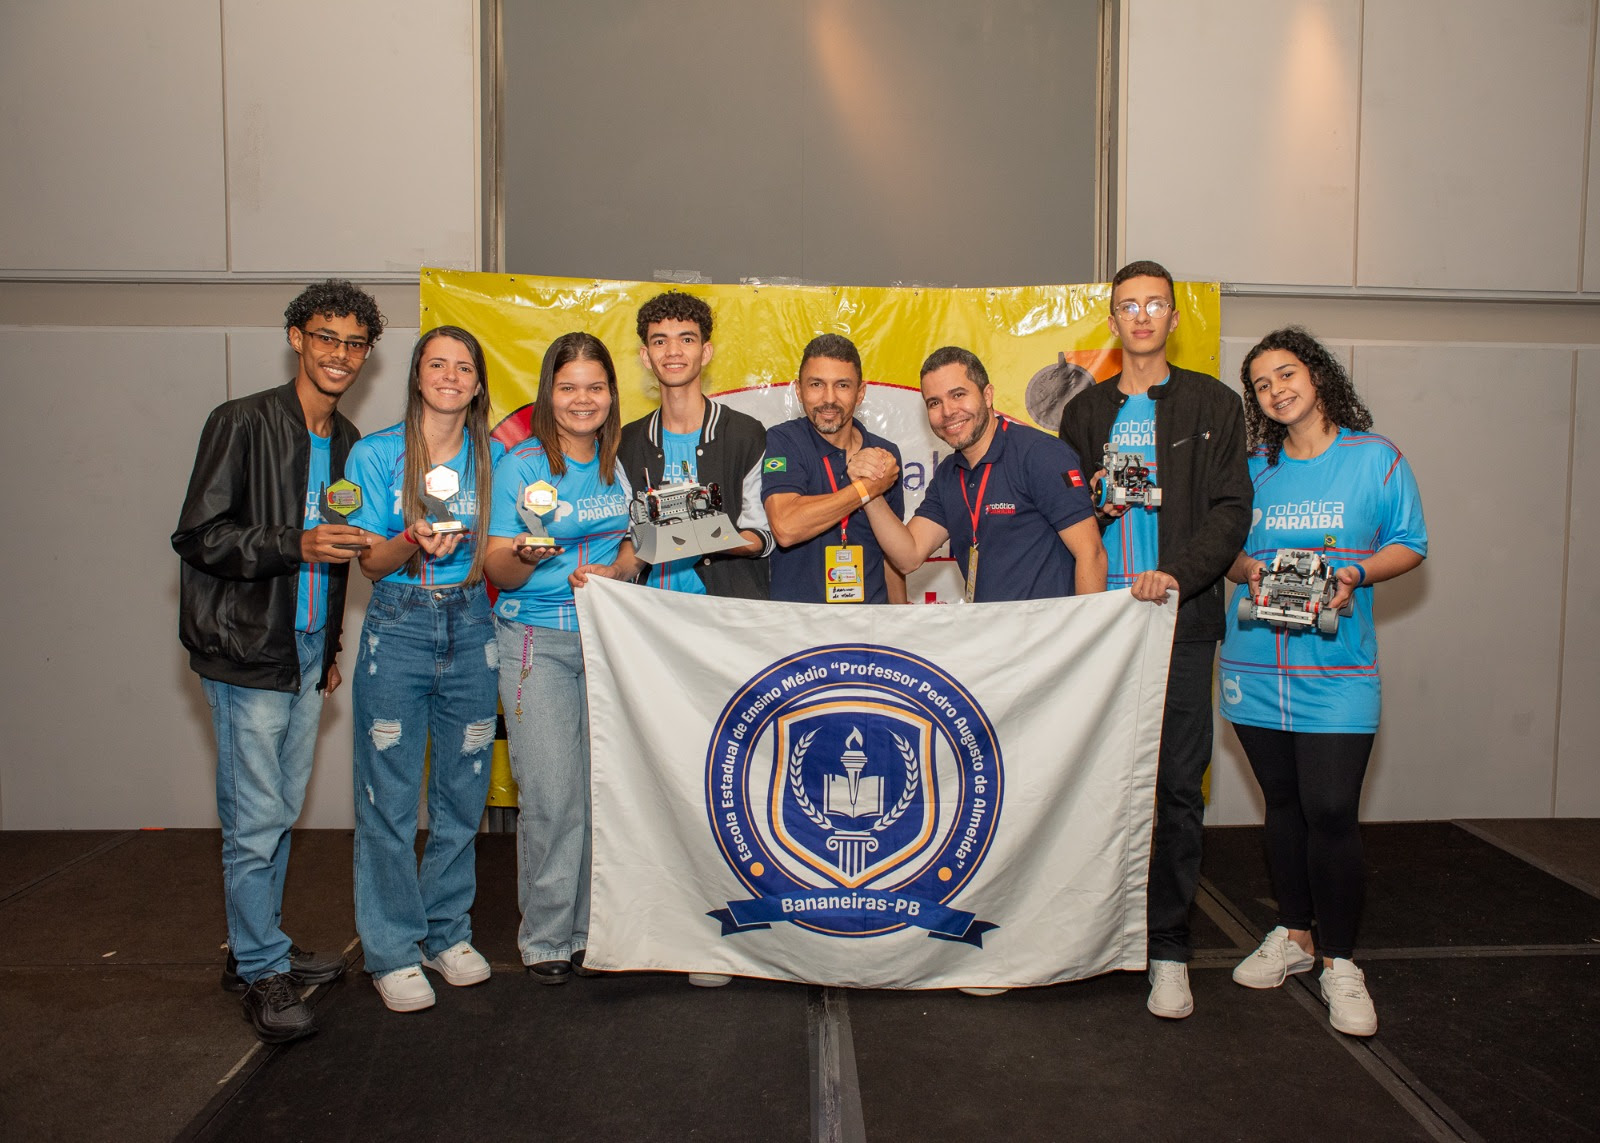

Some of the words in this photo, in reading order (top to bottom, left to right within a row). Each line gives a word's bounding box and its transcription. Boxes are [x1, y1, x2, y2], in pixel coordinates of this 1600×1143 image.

[1112, 419, 1156, 434] robót
[1112, 433, 1156, 446] PARAI
[1266, 499, 1345, 517] robótica
[781, 665, 828, 691] Médio
[741, 687, 782, 723] Ensino
[917, 681, 957, 718] Pedro
[732, 723, 748, 740] de
[953, 716, 984, 772] Augusto
[720, 740, 740, 808] Estadual
[974, 774, 988, 794] de
[726, 811, 753, 862] Escola
[781, 892, 921, 916] Bananeiras-PB
